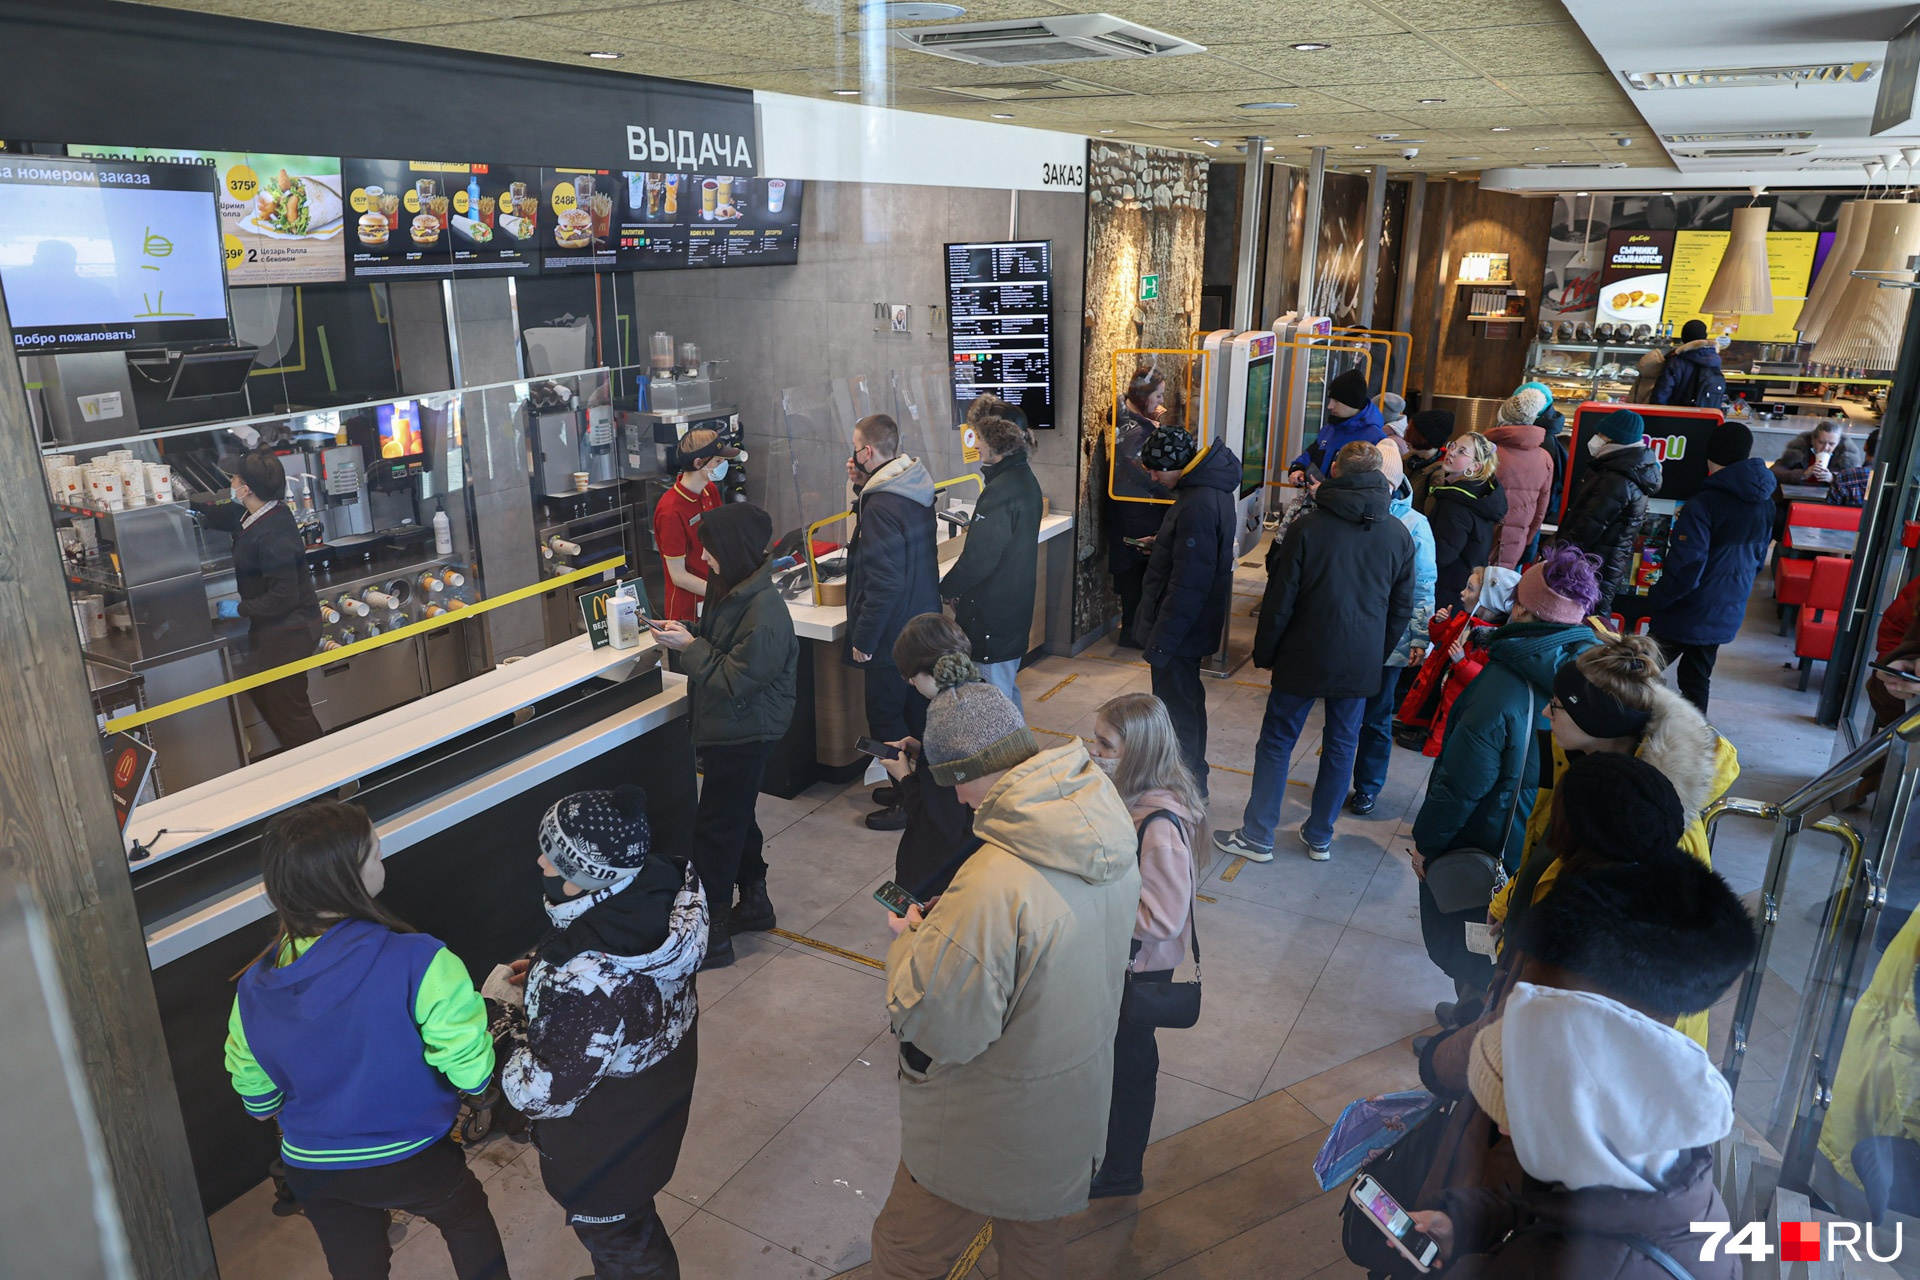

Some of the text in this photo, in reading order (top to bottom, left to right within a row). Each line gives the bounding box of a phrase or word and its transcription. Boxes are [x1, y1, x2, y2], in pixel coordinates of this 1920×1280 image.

[626, 125, 752, 171] ВЫДАЧА
[17, 167, 95, 184] номером
[100, 172, 151, 185] заказа
[1043, 163, 1083, 186] ЗАКАЗ
[248, 249, 258, 262] 2
[260, 248, 286, 256] Цезарь
[1612, 254, 1663, 264] СБЫВАЮТСЯ!
[1619, 246, 1659, 255] СЫРНИКИ
[14, 329, 136, 347] Добро пожаловать!
[556, 835, 618, 881] RUSSIA
